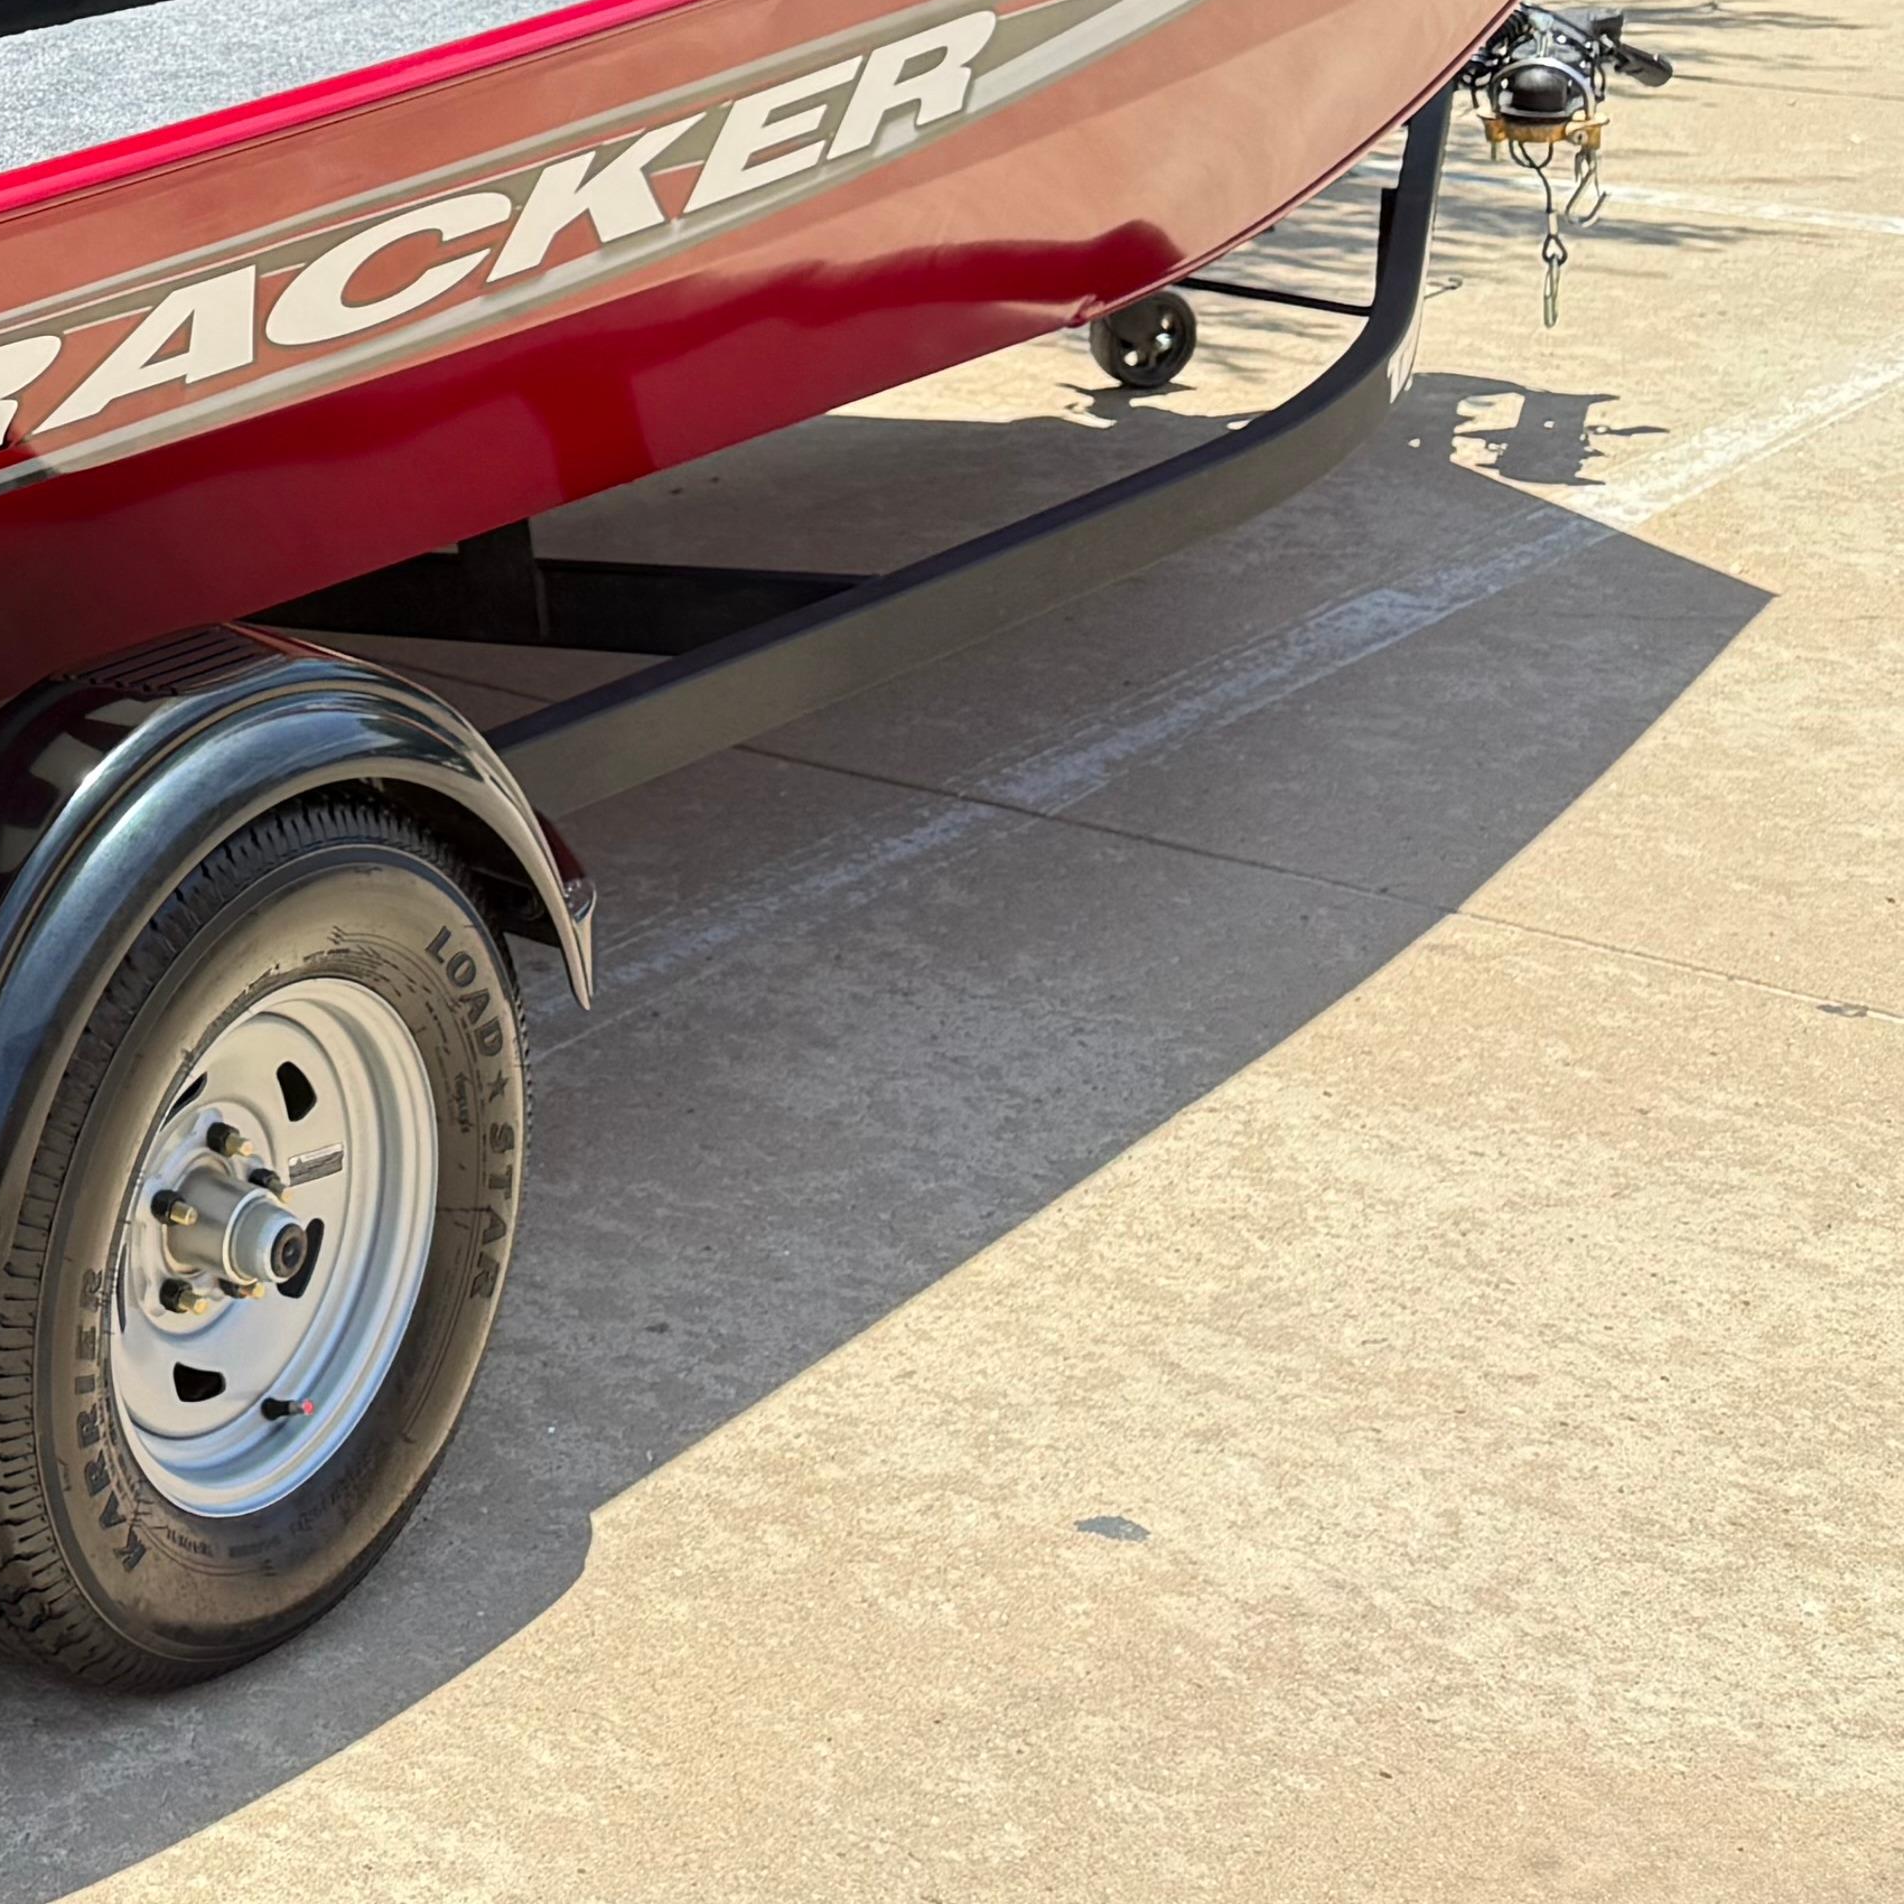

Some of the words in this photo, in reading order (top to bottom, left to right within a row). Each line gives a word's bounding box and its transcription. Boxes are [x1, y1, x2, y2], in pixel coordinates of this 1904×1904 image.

[424, 925, 505, 1058] LOAD
[469, 1121, 515, 1299] STAR
[74, 1268, 147, 1574] KARRIER
